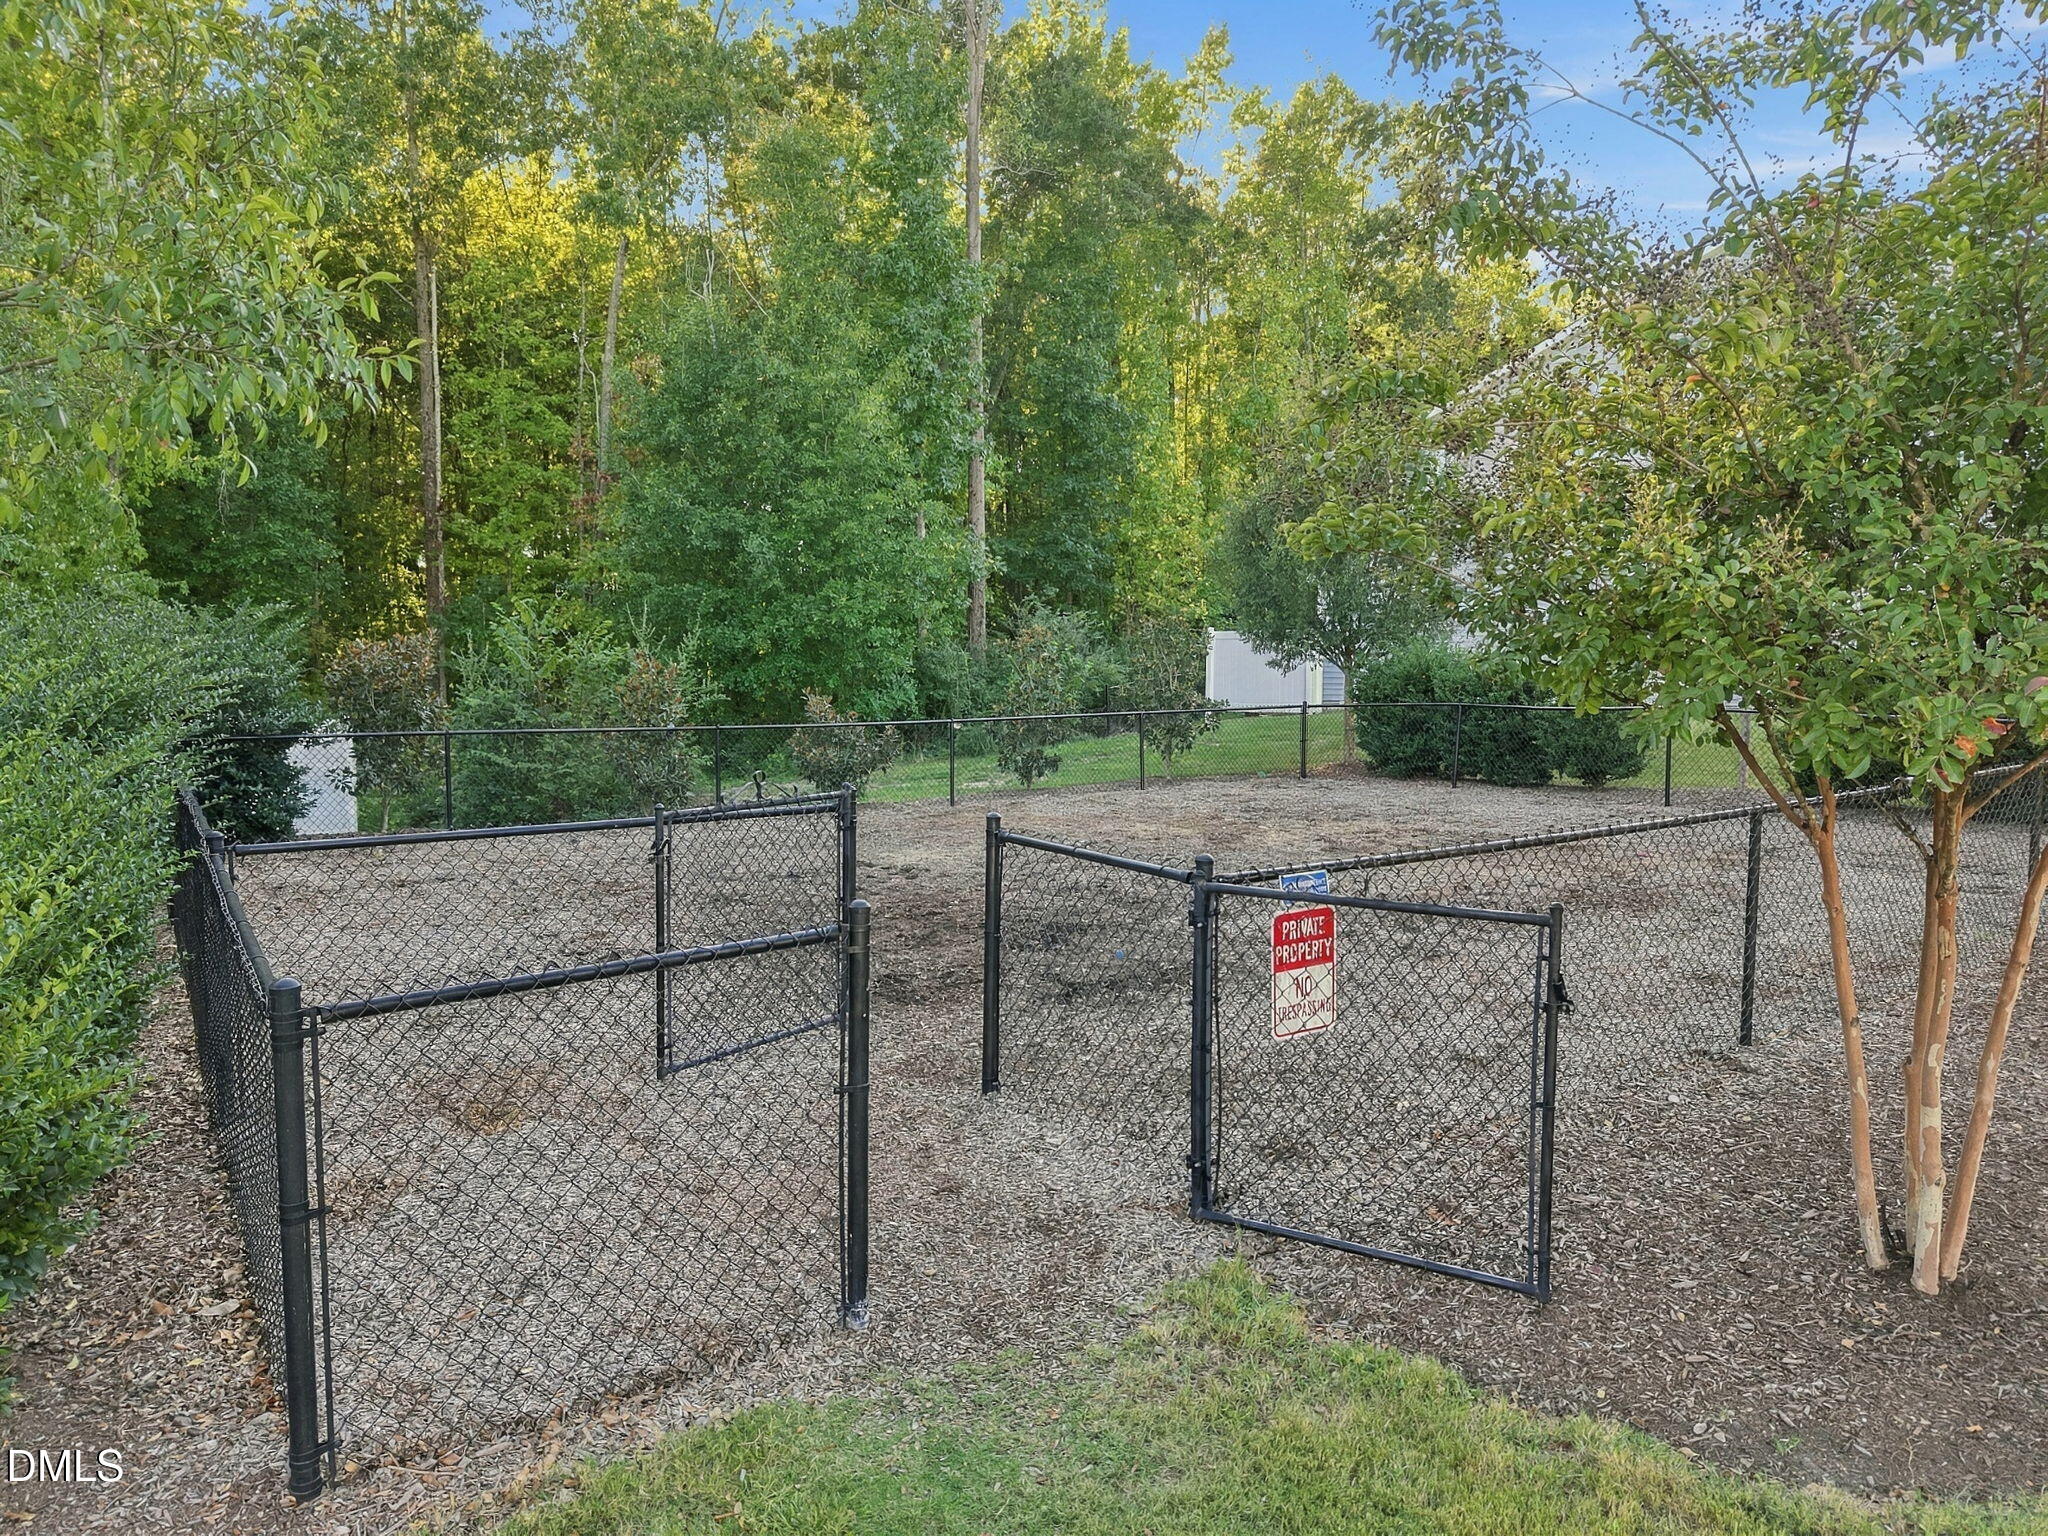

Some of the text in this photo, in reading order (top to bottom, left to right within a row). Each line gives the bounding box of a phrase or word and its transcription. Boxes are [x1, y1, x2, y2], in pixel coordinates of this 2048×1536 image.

[1282, 916, 1326, 940] PRIVATE
[1275, 937, 1333, 965] PROPERTY
[1295, 975, 1313, 999] NO
[1278, 998, 1332, 1021] TRESPASSING
